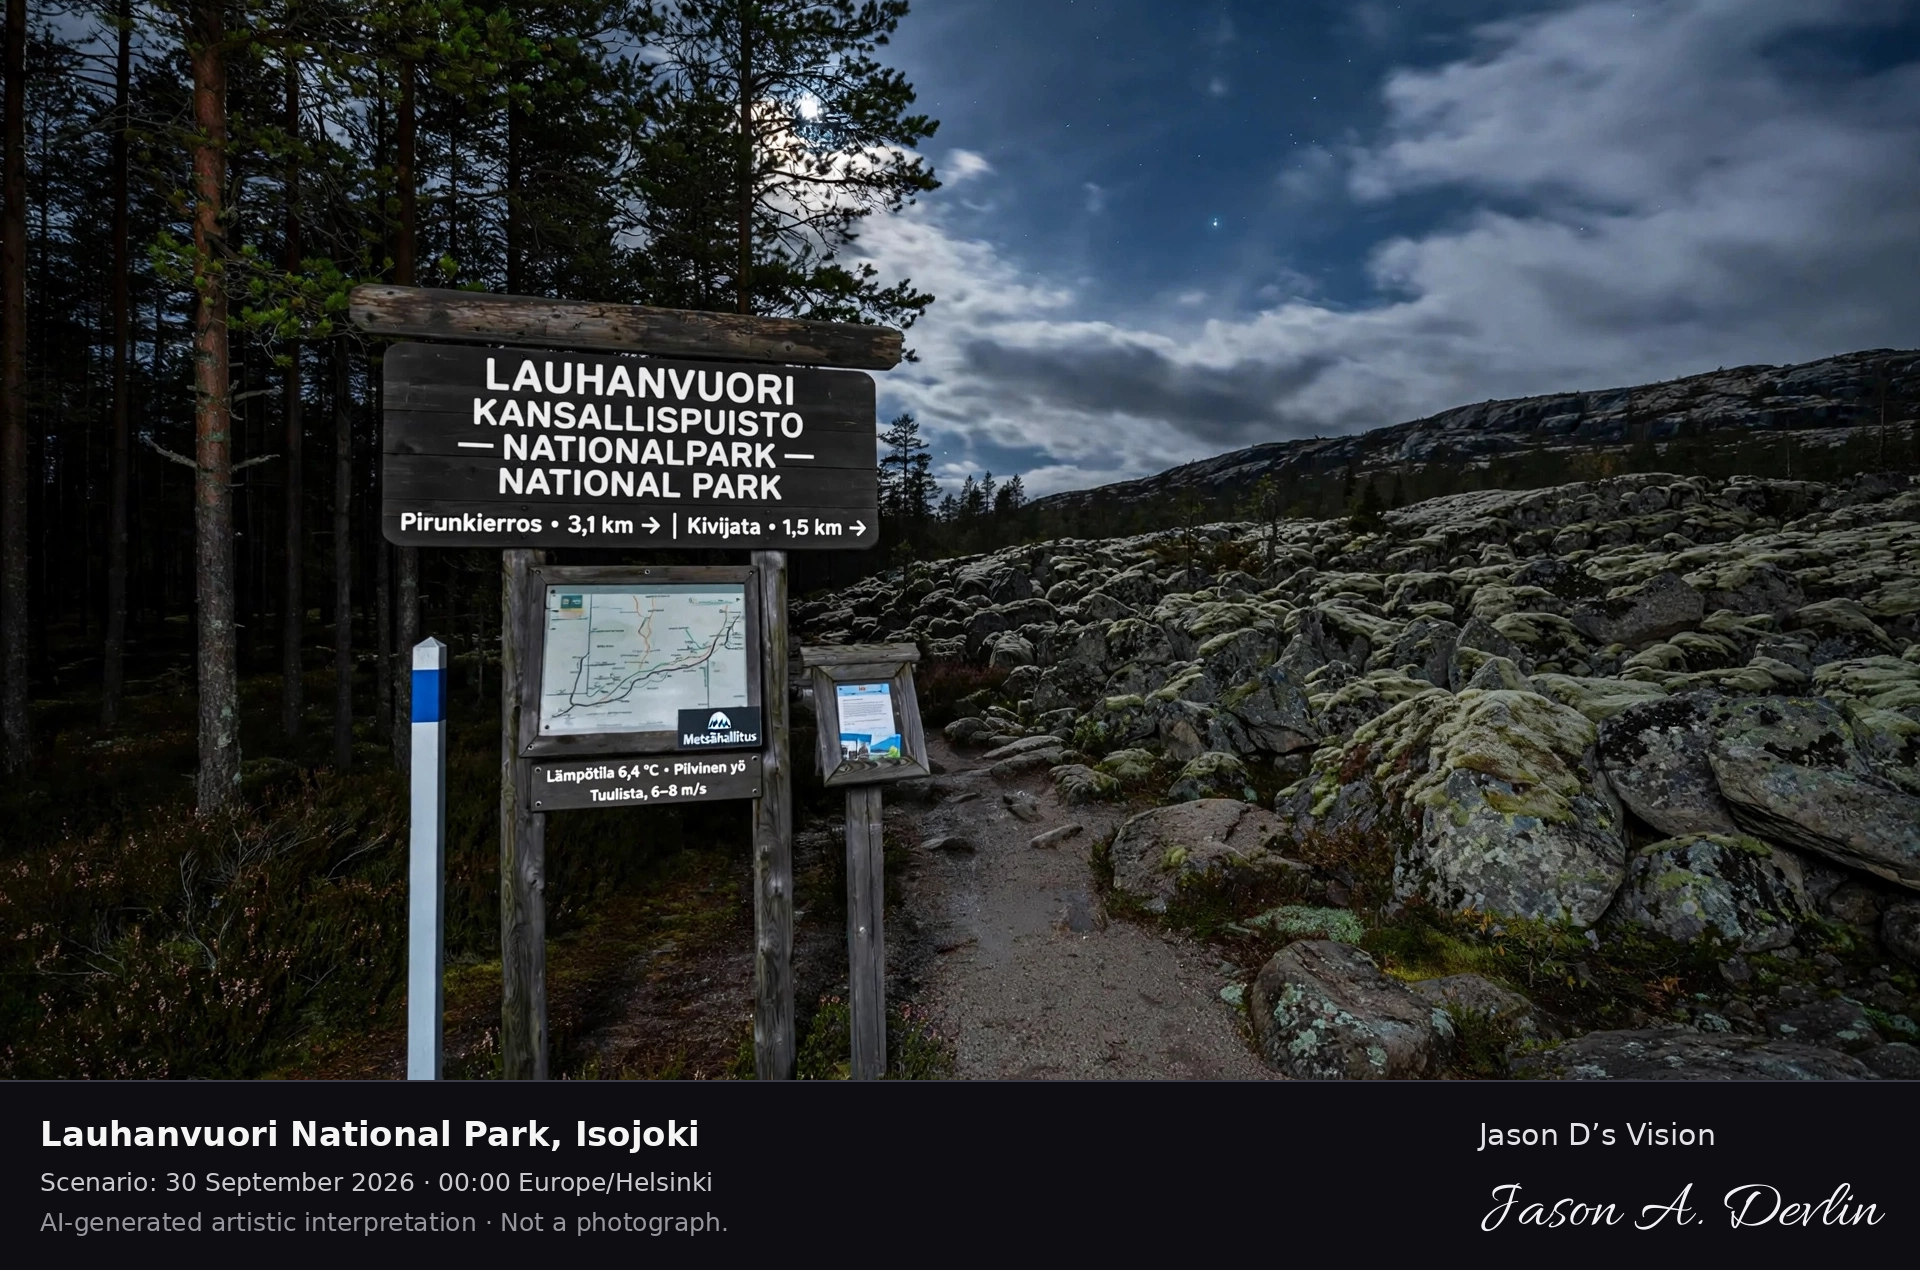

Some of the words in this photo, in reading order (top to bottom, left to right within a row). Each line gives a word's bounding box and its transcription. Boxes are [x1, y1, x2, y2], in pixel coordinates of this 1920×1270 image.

[487, 358, 794, 406] LAUHANVUORI
[473, 397, 803, 439] KANSALLISPUISTO
[503, 433, 776, 469] NATIONALPARK
[499, 467, 682, 499] NATIONAL
[692, 472, 782, 501] PARK
[401, 511, 543, 533] Pirunkierros
[567, 515, 594, 536] 3,1
[601, 515, 633, 533] km
[687, 516, 761, 540] Kivijata
[782, 519, 809, 539] 1,5
[814, 518, 843, 536] km
[546, 766, 615, 784] Lämpötila
[617, 765, 642, 783] 6,4
[643, 764, 660, 778] °C
[673, 762, 727, 776] Pilvinen
[730, 760, 746, 775] yö
[589, 787, 649, 802] Tuulista,
[681, 782, 708, 798] m/s
